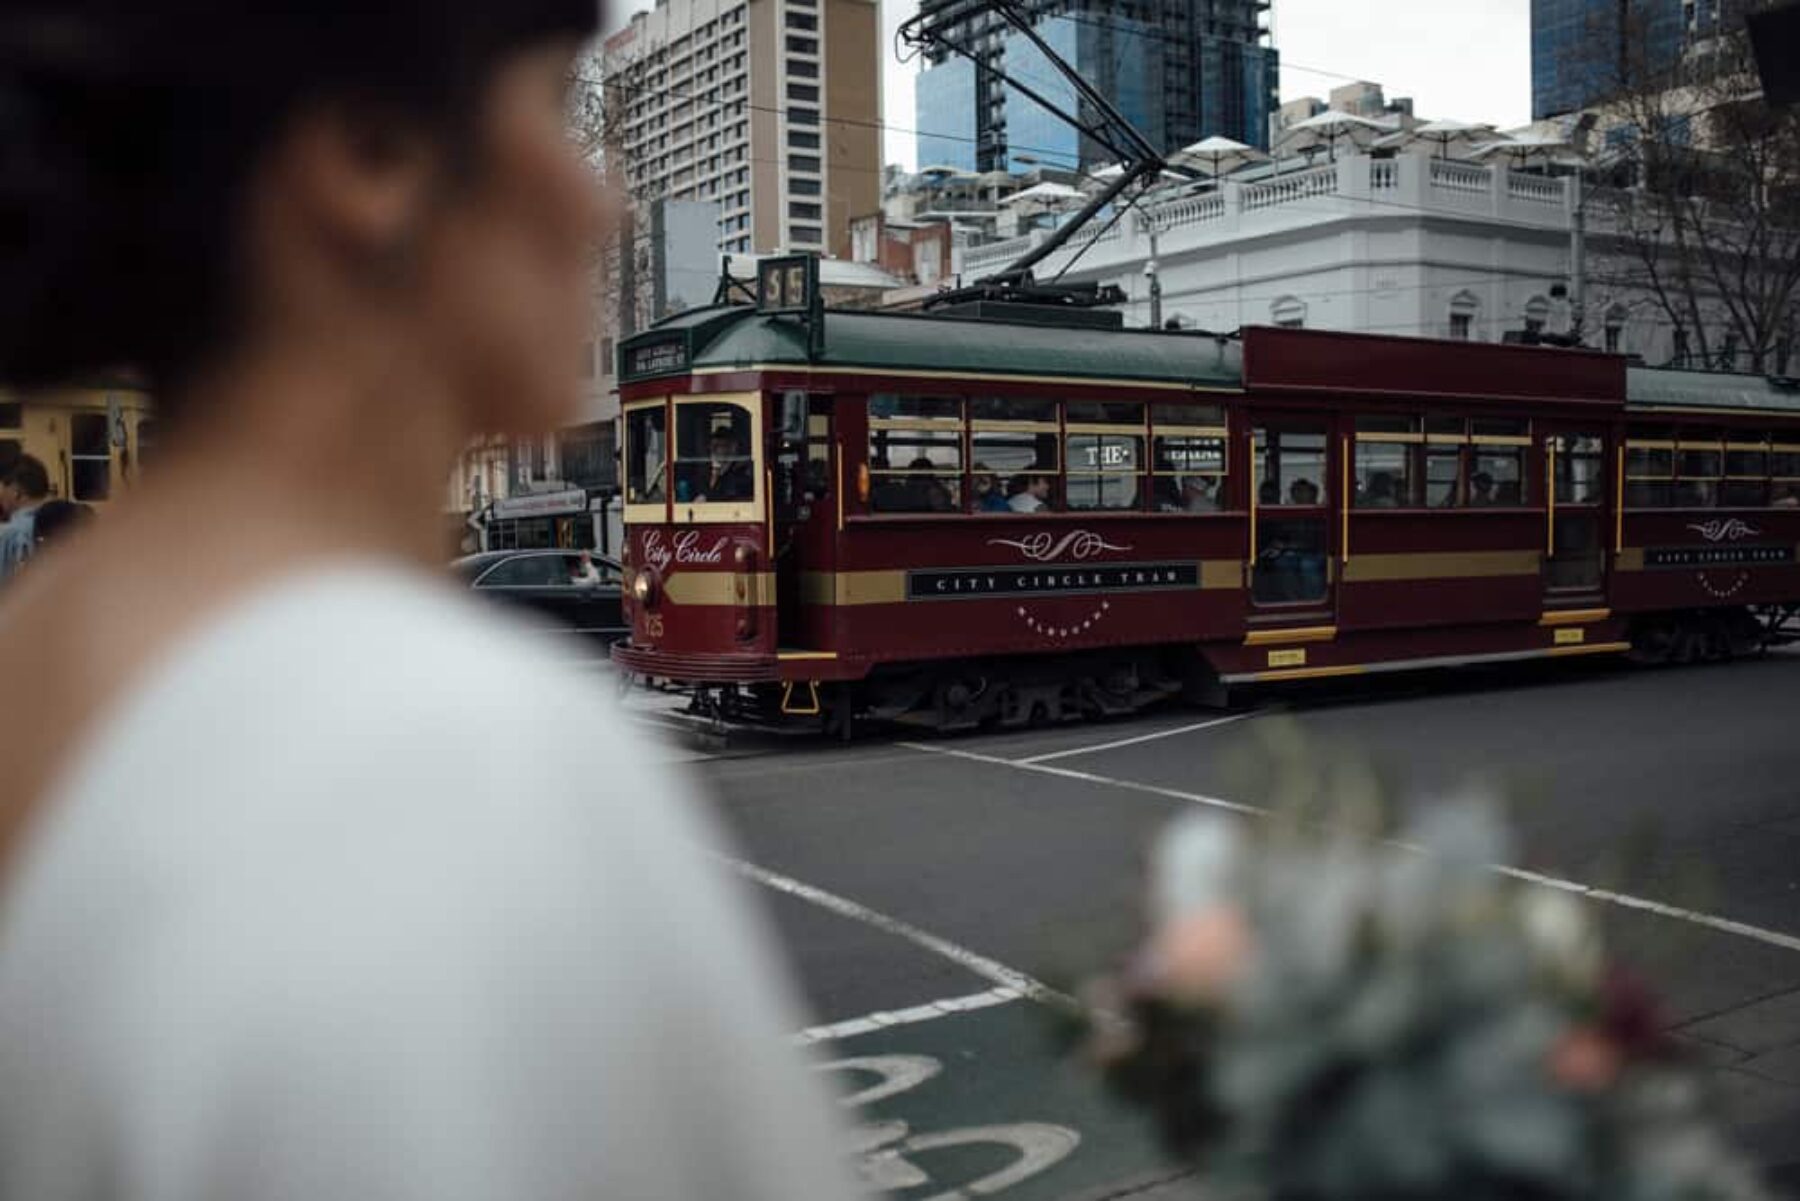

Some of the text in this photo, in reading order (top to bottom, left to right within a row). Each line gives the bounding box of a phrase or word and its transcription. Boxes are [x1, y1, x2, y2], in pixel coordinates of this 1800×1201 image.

[642, 530, 729, 571] City Circle
[936, 571, 1176, 590] CITY CIRCLE TRAM
